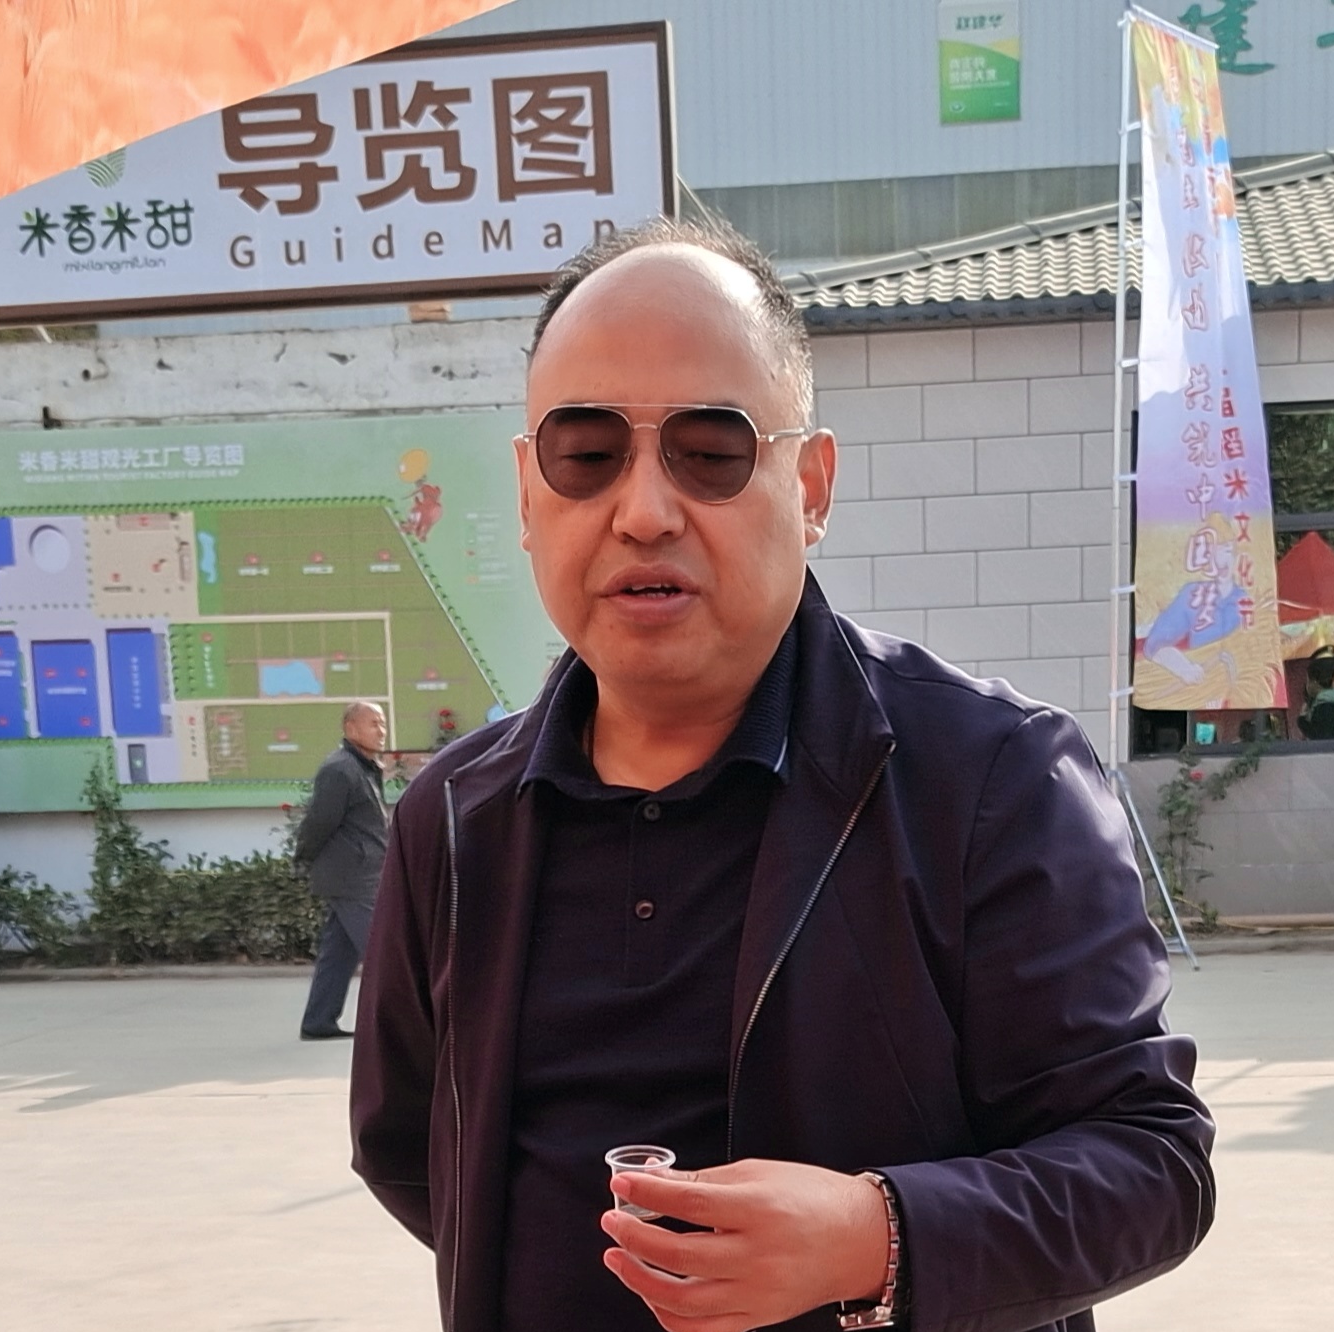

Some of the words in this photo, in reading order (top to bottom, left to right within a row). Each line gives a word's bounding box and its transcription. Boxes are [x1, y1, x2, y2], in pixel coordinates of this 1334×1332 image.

[218, 70, 615, 216] 导览图
[19, 198, 195, 257] 米香米甜
[229, 221, 445, 268] Guide
